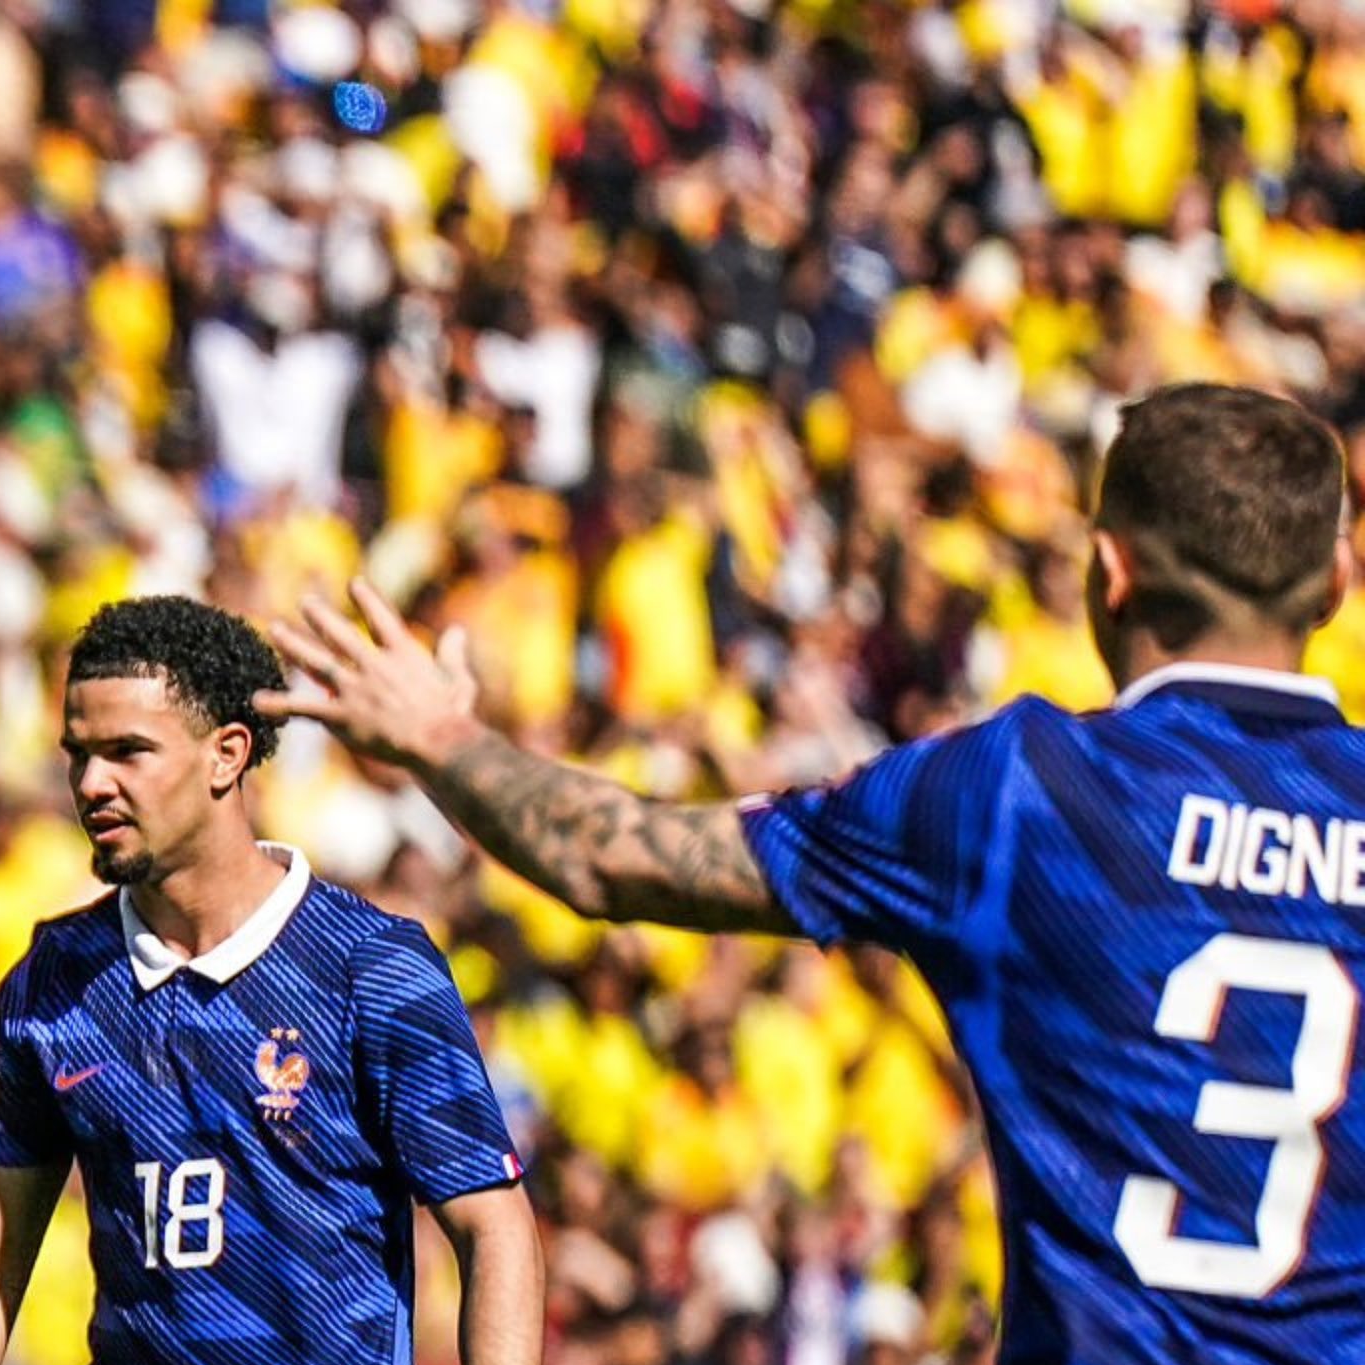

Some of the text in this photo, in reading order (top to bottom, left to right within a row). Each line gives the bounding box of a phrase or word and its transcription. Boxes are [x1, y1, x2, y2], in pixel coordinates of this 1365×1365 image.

[1167, 792, 1365, 906] DIGNE
[1113, 932, 1357, 1298] 3
[135, 1158, 224, 1269] 18
